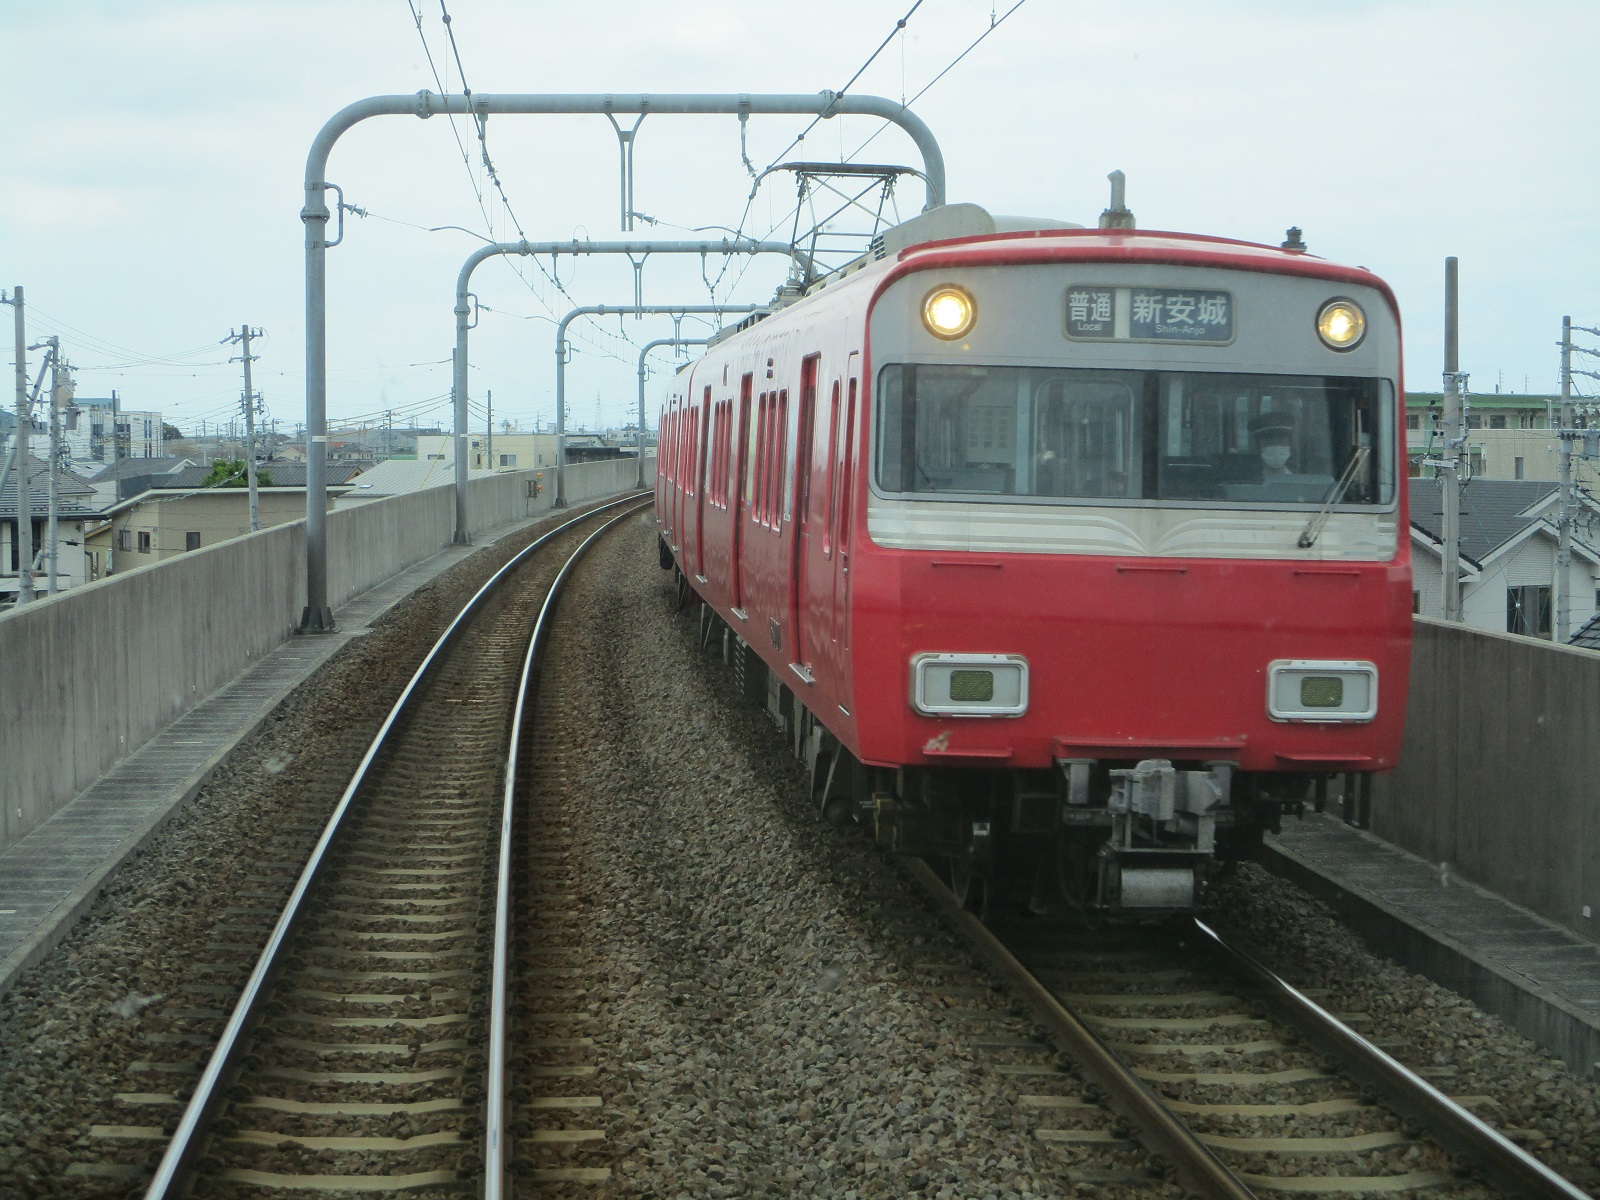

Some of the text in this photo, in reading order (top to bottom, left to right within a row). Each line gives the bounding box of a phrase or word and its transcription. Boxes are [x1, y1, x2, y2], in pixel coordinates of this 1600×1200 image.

[1069, 292, 1111, 322] 普通
[1133, 294, 1227, 325] 新安城
[1077, 322, 1102, 331] Local
